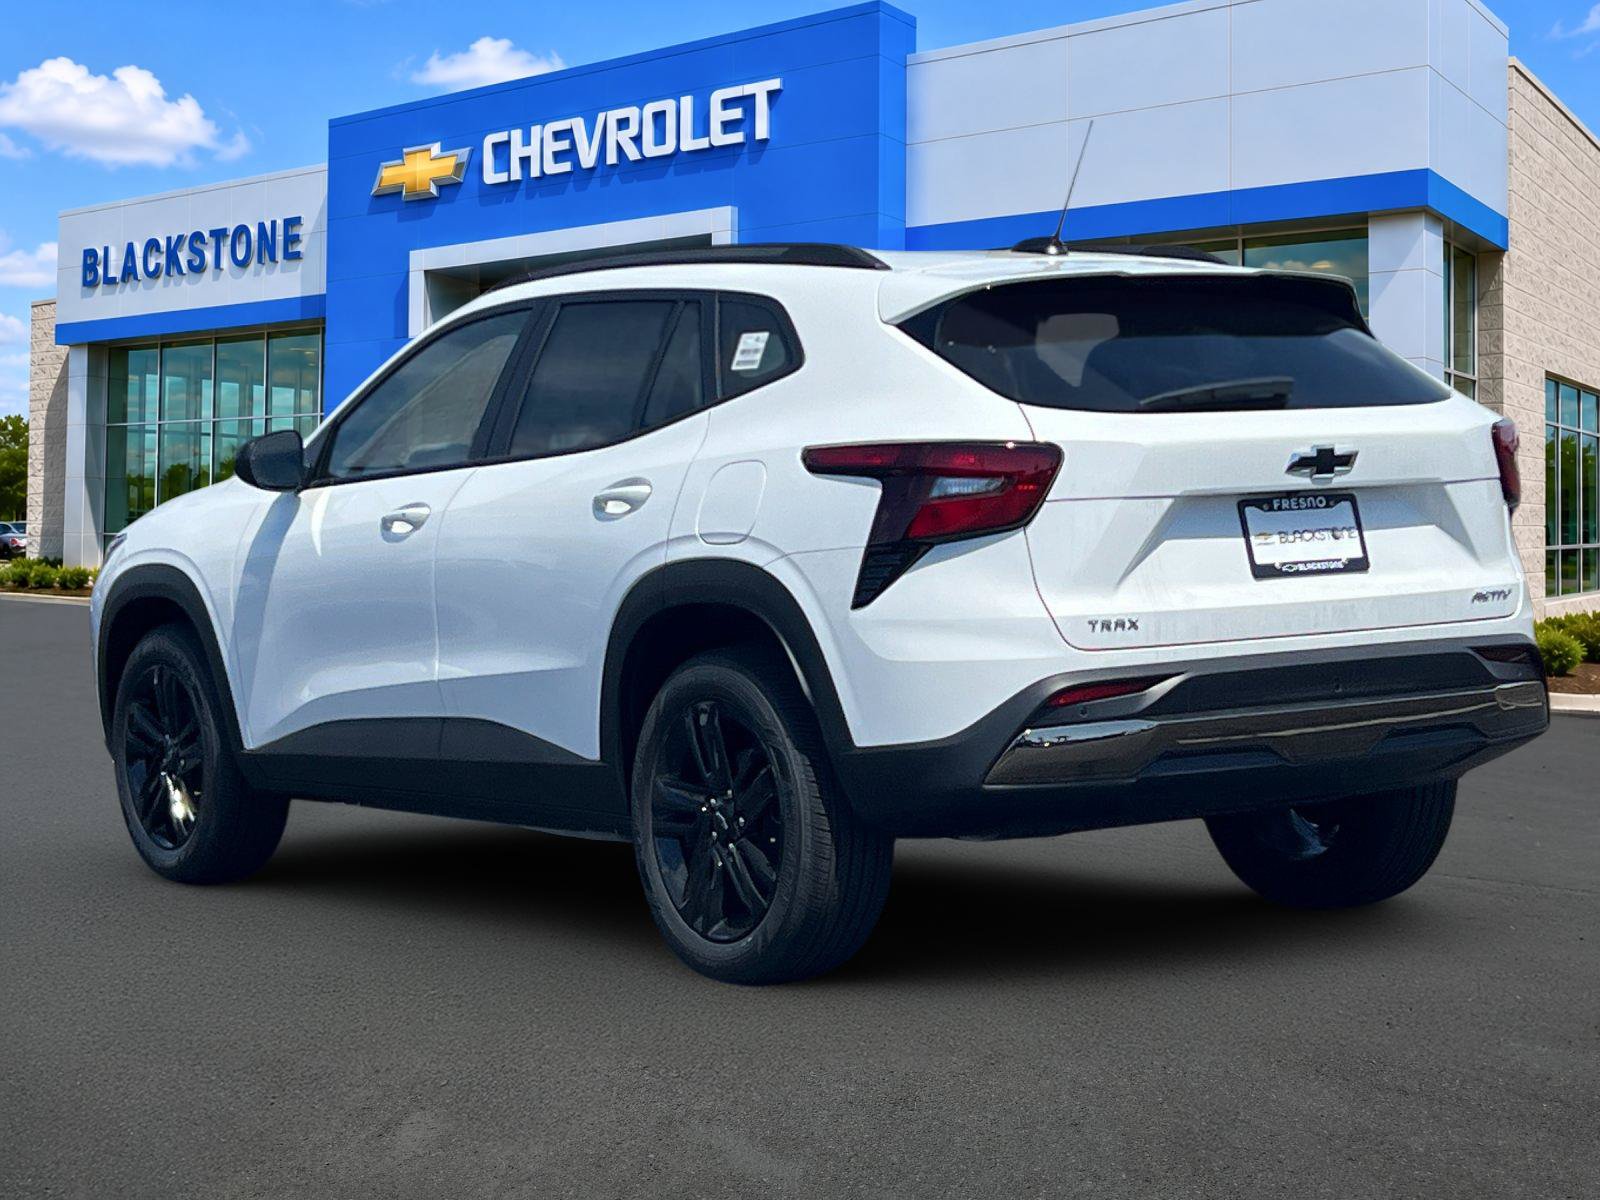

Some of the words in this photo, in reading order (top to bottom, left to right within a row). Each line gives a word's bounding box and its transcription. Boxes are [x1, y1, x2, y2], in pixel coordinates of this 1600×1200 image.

[483, 78, 783, 184] CHEVROLET
[82, 216, 303, 287] BLACKSTONE
[1272, 496, 1326, 510] FRESNO
[1088, 618, 1139, 633] TRAX
